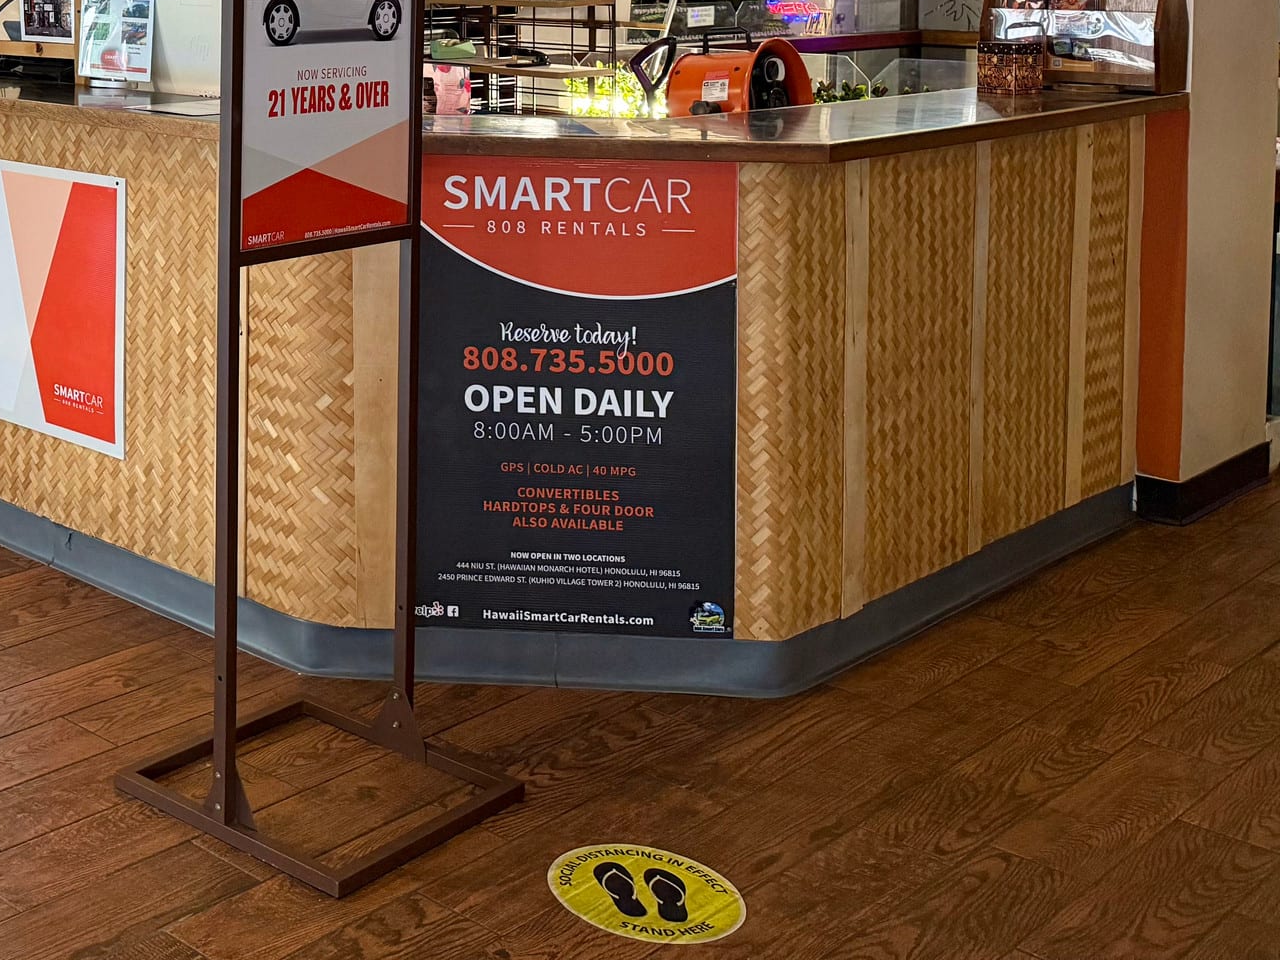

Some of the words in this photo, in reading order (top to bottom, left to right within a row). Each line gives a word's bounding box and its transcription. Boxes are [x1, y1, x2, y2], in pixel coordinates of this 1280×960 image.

[297, 69, 318, 80] NOW
[321, 65, 367, 80] SERVICING
[268, 89, 286, 118] 21
[291, 84, 336, 114] YEARS
[339, 83, 352, 111] &
[356, 81, 389, 109] OVER
[443, 175, 692, 214] SMARTCAR
[486, 220, 527, 234] 808
[541, 221, 647, 237] RENTALS
[247, 231, 285, 245] SMARTCAR
[499, 321, 572, 344] Reserve
[574, 322, 637, 360] today!
[463, 346, 674, 377] 808.735.5000
[54, 383, 103, 409] SMARTCAR
[464, 384, 563, 415] OPEN
[574, 388, 674, 418] DAILY
[473, 421, 555, 441] 8:00AM
[580, 424, 663, 445] 5:00PM
[500, 462, 524, 473] GPS
[533, 463, 565, 474] COLD
[568, 464, 583, 475] AC
[592, 465, 607, 476] 40
[610, 466, 637, 477] MPG
[517, 487, 620, 501] CONVERTIBLES
[483, 500, 556, 514] HARDTOPS
[559, 503, 570, 514] &
[573, 503, 611, 516] FOUR
[614, 505, 654, 518] DOOR
[512, 516, 548, 528] ALSO
[551, 517, 624, 531] AVAILABLE
[510, 551, 530, 559] NOW
[530, 552, 552, 560] OPEN
[563, 553, 581, 561] TWO
[582, 554, 626, 563] LOCATIONS
[456, 561, 470, 569] 444
[485, 562, 496, 570] ST.
[497, 563, 536, 572] (HAWAIIAN
[537, 564, 575, 573] MONARCH
[576, 566, 603, 575] HOTEL)
[604, 568, 648, 577] HONOLULU,
[437, 573, 455, 581] 2450
[456, 573, 483, 582] PRINCE
[484, 575, 516, 583] EDWARD
[516, 575, 527, 584] ST.
[528, 576, 555, 585] (KUHIO
[556, 577, 585, 586] VILLAGE
[587, 579, 613, 587] TOWER
[614, 580, 622, 588] 2)
[623, 580, 667, 590] HONOLULU,
[415, 605, 433, 618] elp
[483, 609, 654, 625] HawaiiSmartCarRentals.com
[559, 861, 579, 887] SOCIAL
[576, 848, 663, 864] DISTANCING
[667, 857, 684, 868] IN
[685, 865, 728, 895] EFFECT
[620, 921, 676, 937] STAND
[679, 921, 715, 937] HERE
